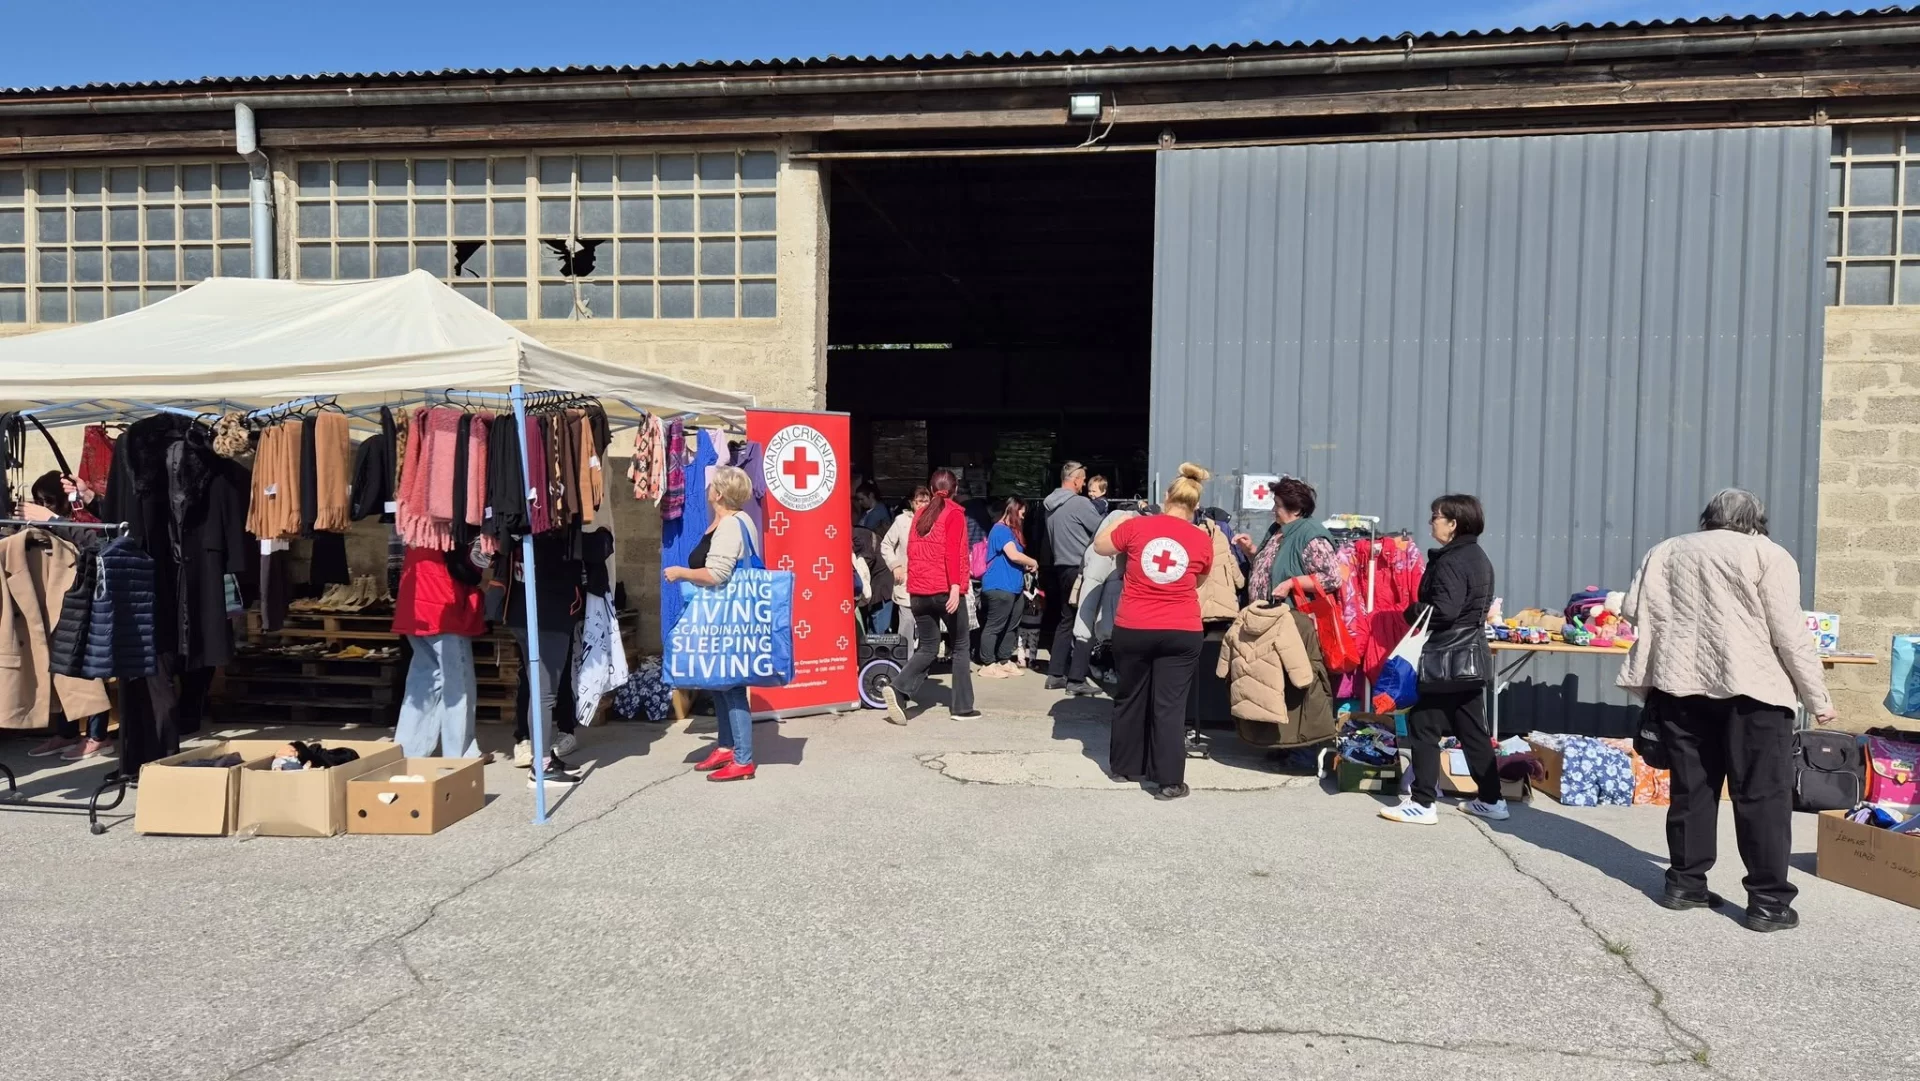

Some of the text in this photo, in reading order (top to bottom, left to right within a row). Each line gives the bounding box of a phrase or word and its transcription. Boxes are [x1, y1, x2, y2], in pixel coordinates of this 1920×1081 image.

[765, 429, 791, 491] HRVATSKI
[792, 426, 832, 458] CRVENI
[678, 600, 772, 623] IVING
[673, 624, 771, 636] SCANDINAVIAN
[671, 636, 772, 653] SLEEPING
[671, 653, 773, 678] LIVING
